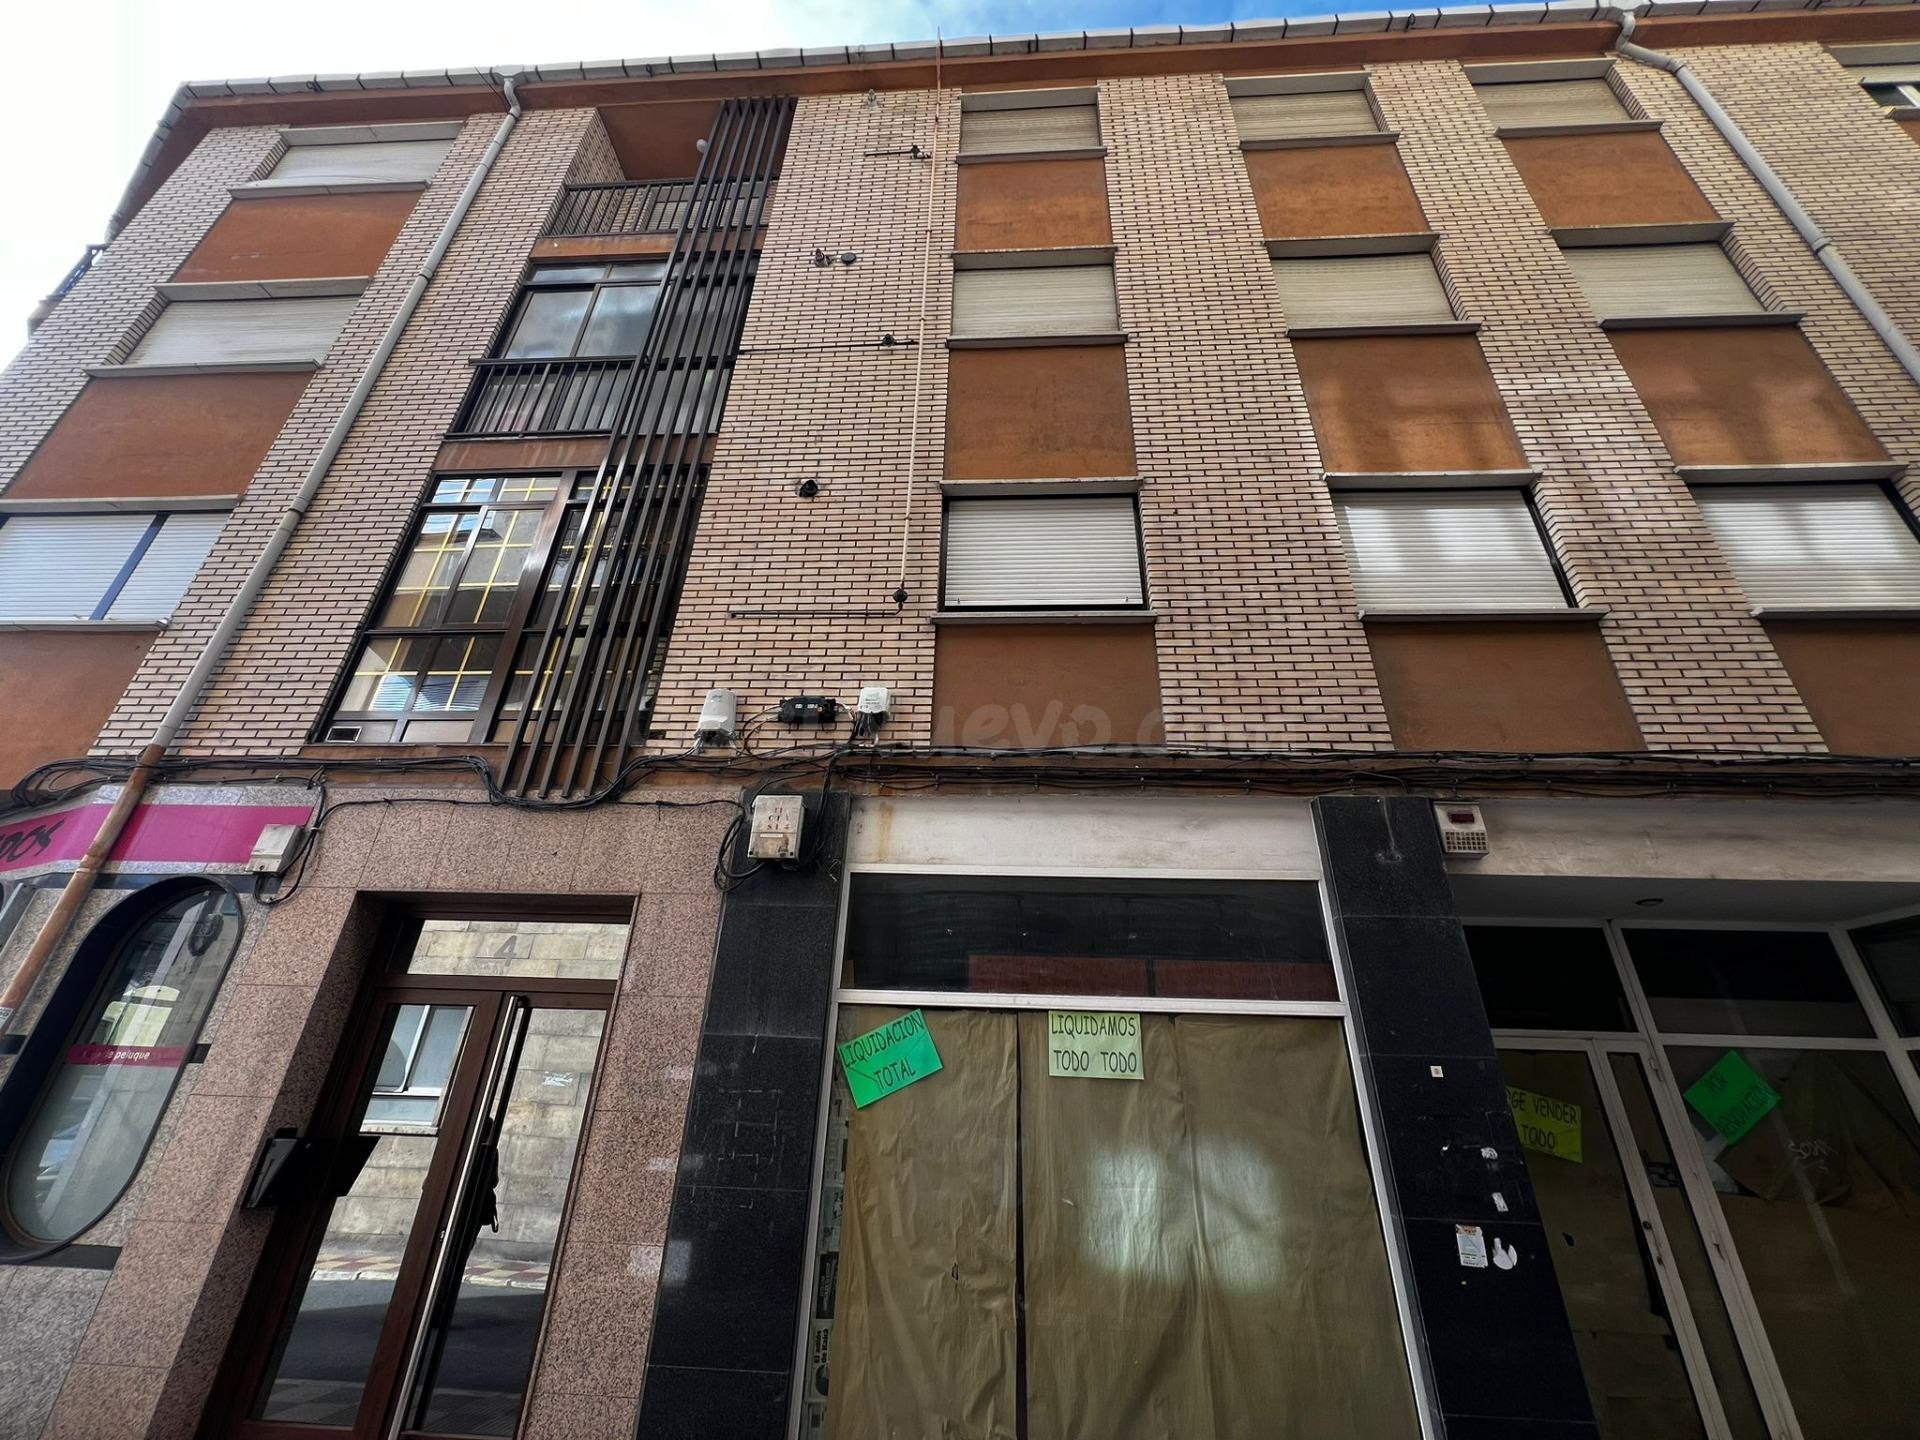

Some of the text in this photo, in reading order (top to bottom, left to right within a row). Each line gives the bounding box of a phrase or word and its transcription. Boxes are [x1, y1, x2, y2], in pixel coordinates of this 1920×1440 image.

[494, 934, 517, 967] 4
[840, 1011, 925, 1068] LIQUIDACION
[1051, 1014, 1137, 1039] LIQUIDAMOS
[873, 1056, 917, 1091] TOTAL
[1053, 1050, 1137, 1073] TODO TODO
[1532, 1096, 1578, 1127] VENDER
[1521, 1124, 1556, 1150] TODO
